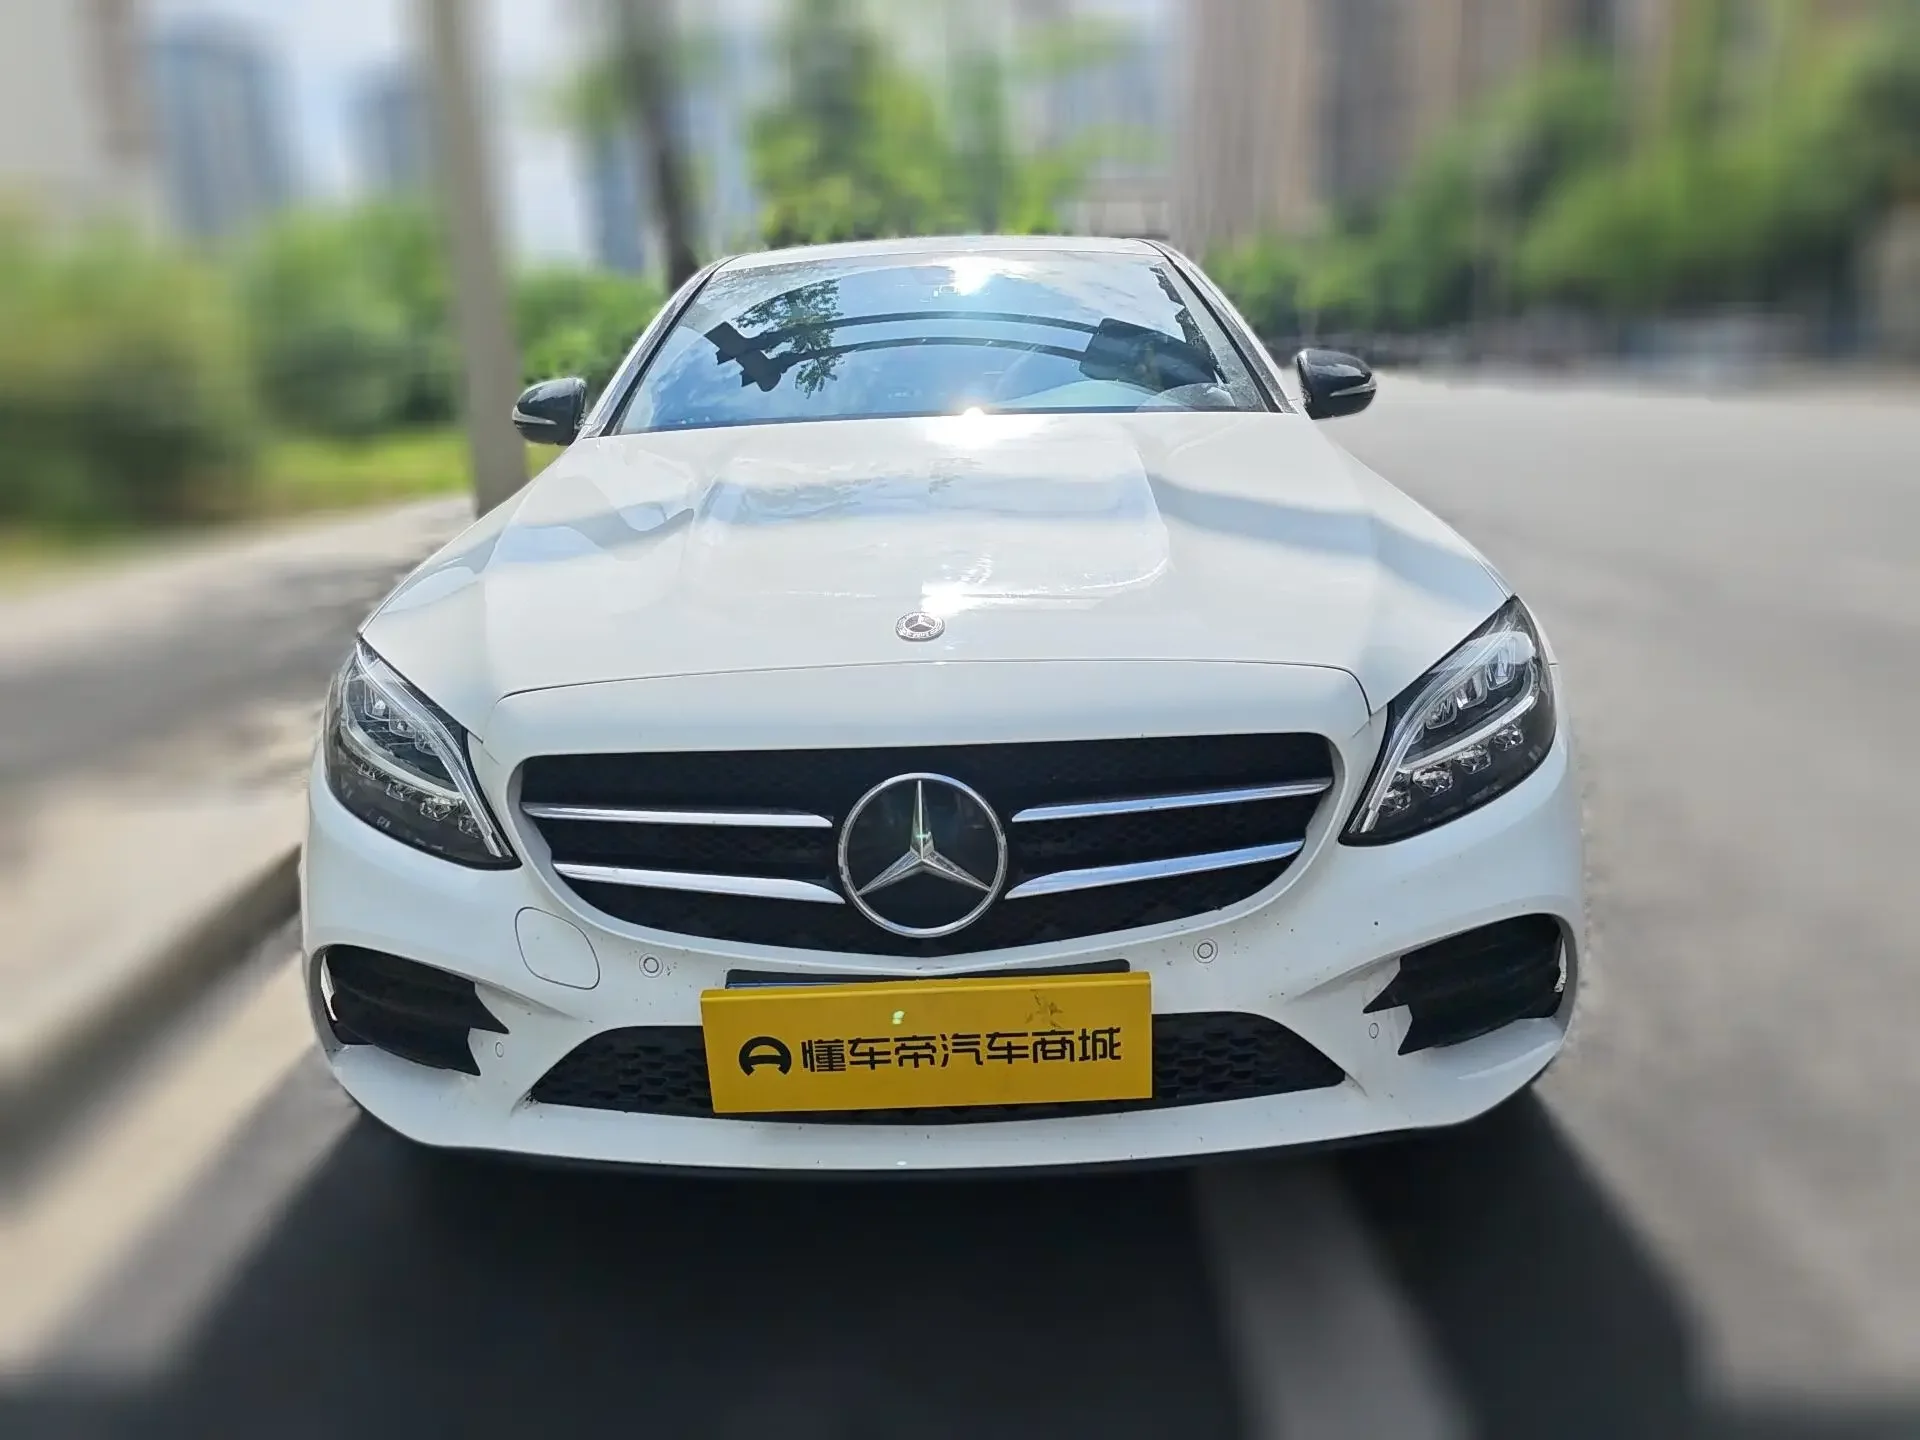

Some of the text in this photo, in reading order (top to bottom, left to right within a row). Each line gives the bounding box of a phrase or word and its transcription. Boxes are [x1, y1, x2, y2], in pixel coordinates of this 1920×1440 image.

[800, 1027, 1122, 1073] 懂车帝汽车商城
